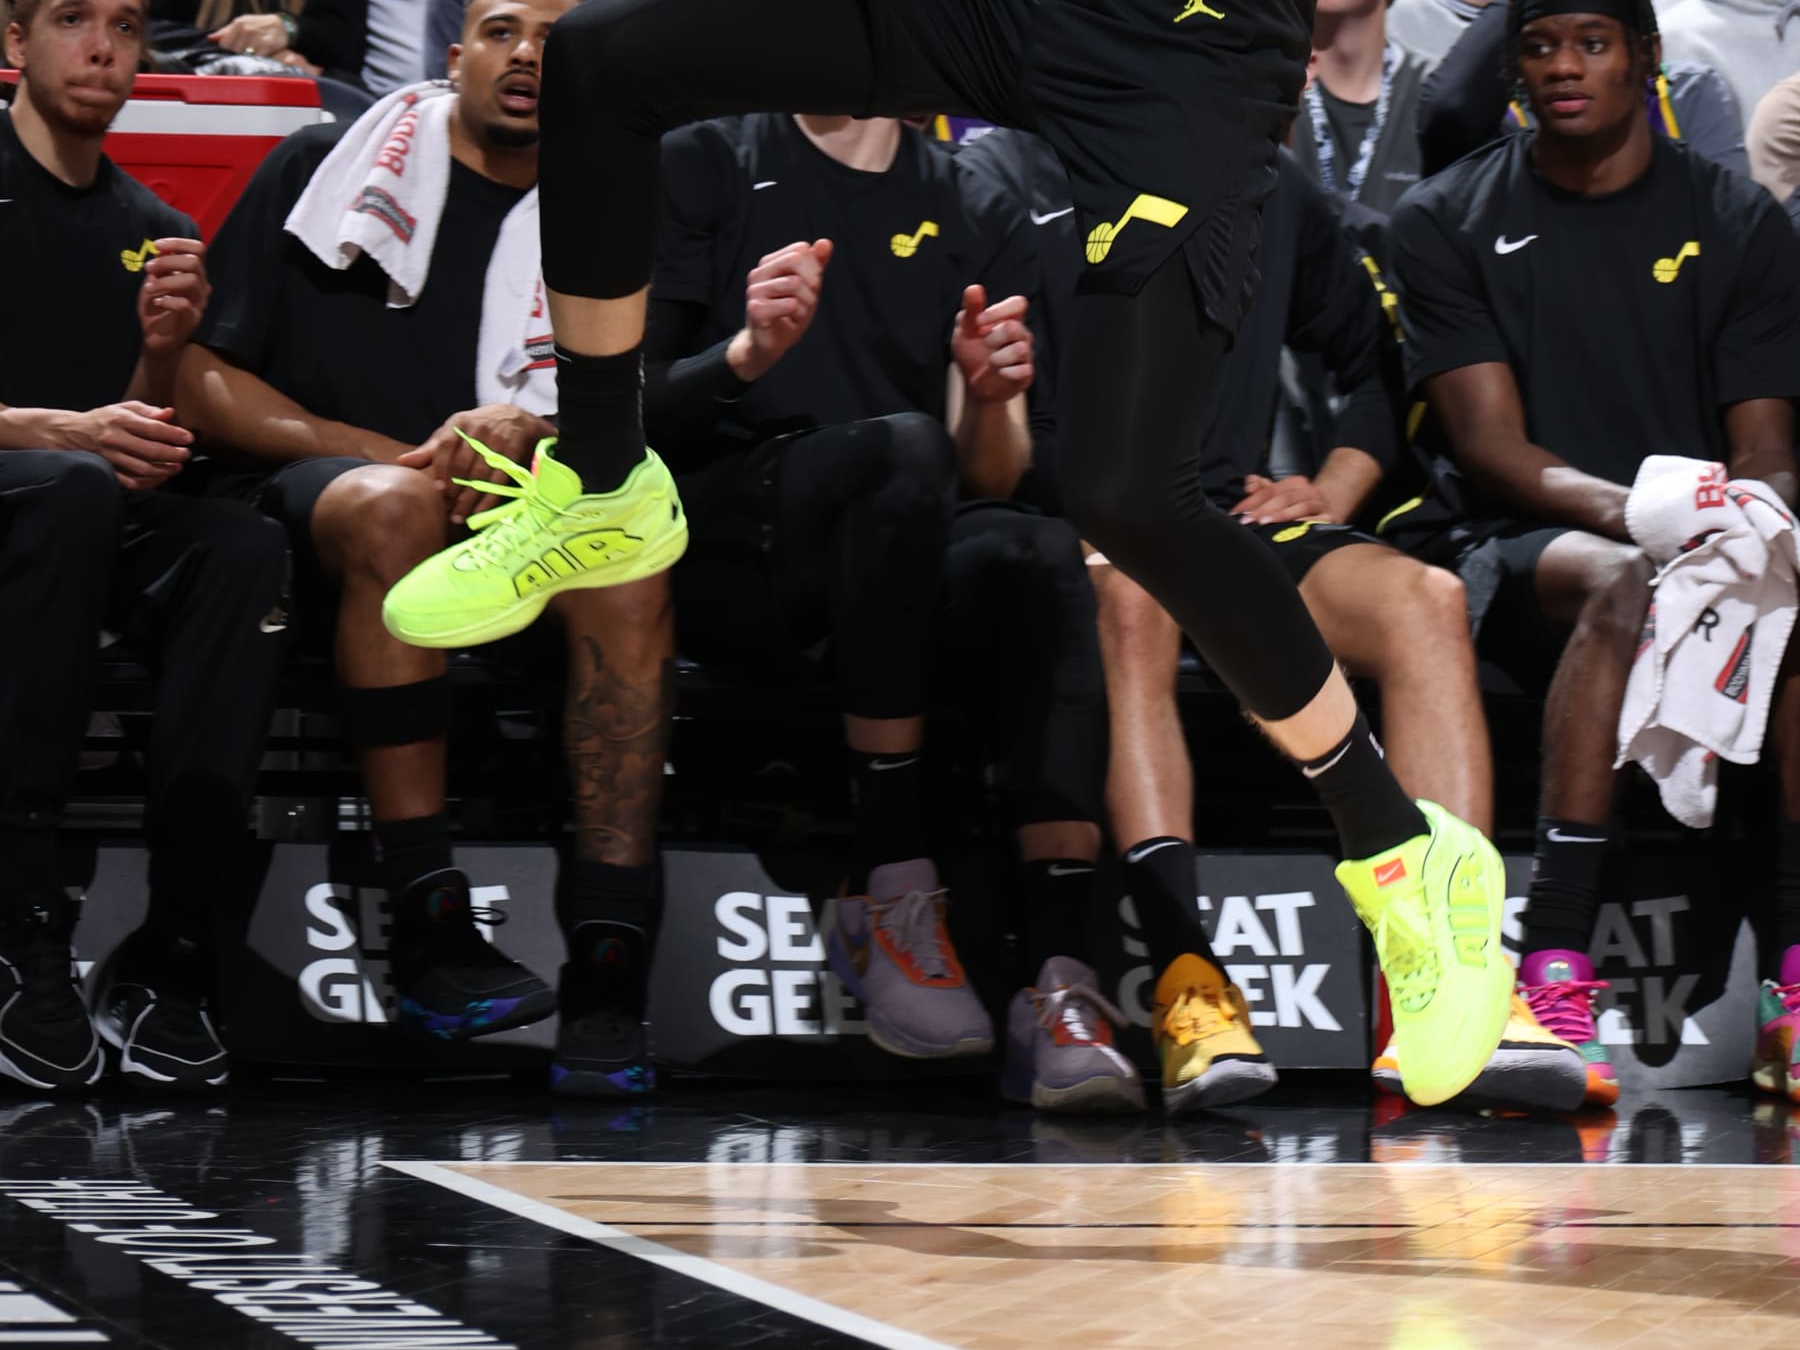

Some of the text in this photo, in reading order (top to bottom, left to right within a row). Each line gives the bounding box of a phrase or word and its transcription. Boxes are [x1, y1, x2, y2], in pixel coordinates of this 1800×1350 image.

[512, 527, 644, 598] AIR
[304, 882, 511, 951] SET
[714, 891, 840, 962] SE
[1117, 891, 1316, 957] AT
[298, 957, 398, 1024] GE
[709, 968, 868, 1036] GEE
[1117, 963, 1344, 1032] EK
[122, 1250, 520, 1350] NIVERSITY
